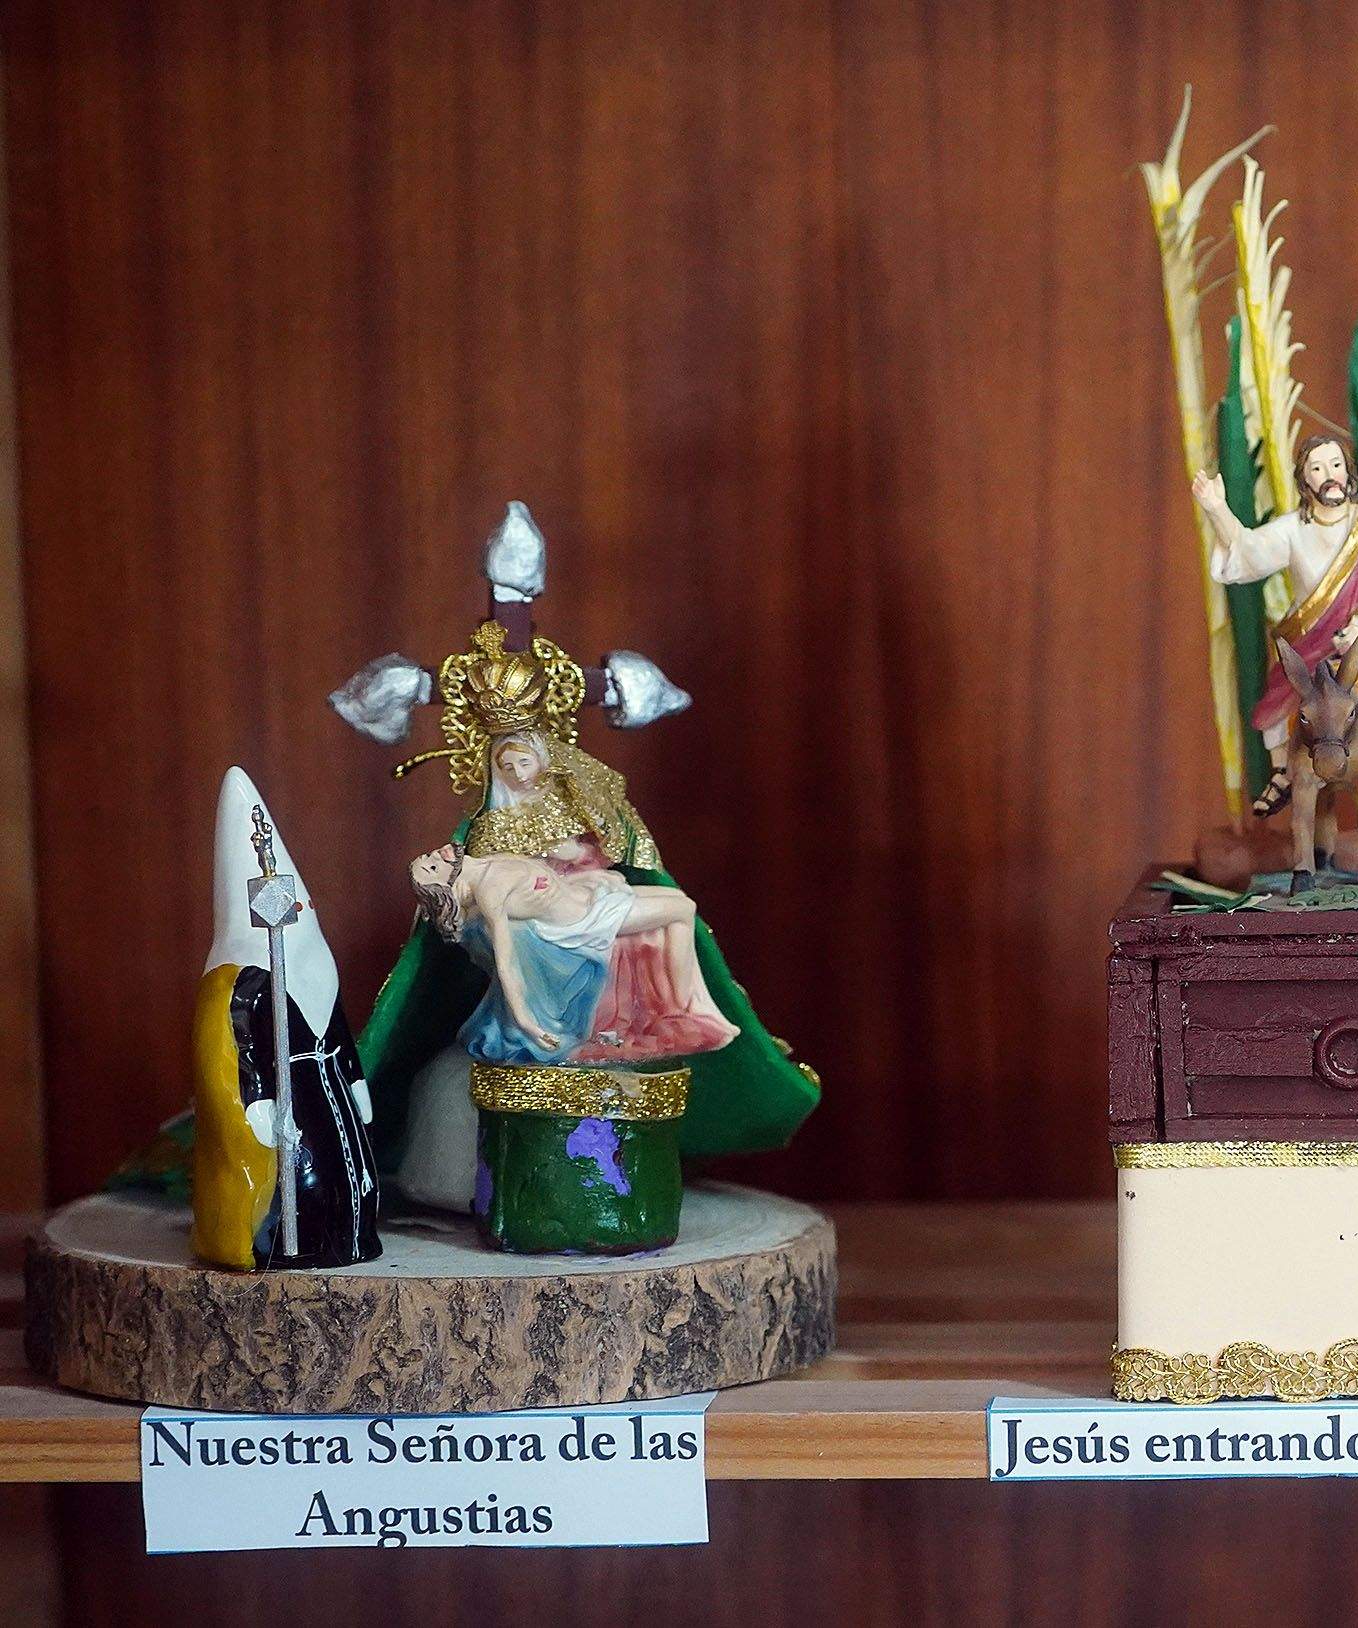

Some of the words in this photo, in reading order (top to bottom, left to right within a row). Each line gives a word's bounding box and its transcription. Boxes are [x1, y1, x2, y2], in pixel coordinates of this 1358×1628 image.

[149, 1418, 352, 1467] Nuestra
[367, 1418, 545, 1464] Señora
[558, 1417, 616, 1460] de
[631, 1416, 698, 1460] las
[995, 1419, 1129, 1477] Jesús
[295, 1490, 553, 1547] Angustias
